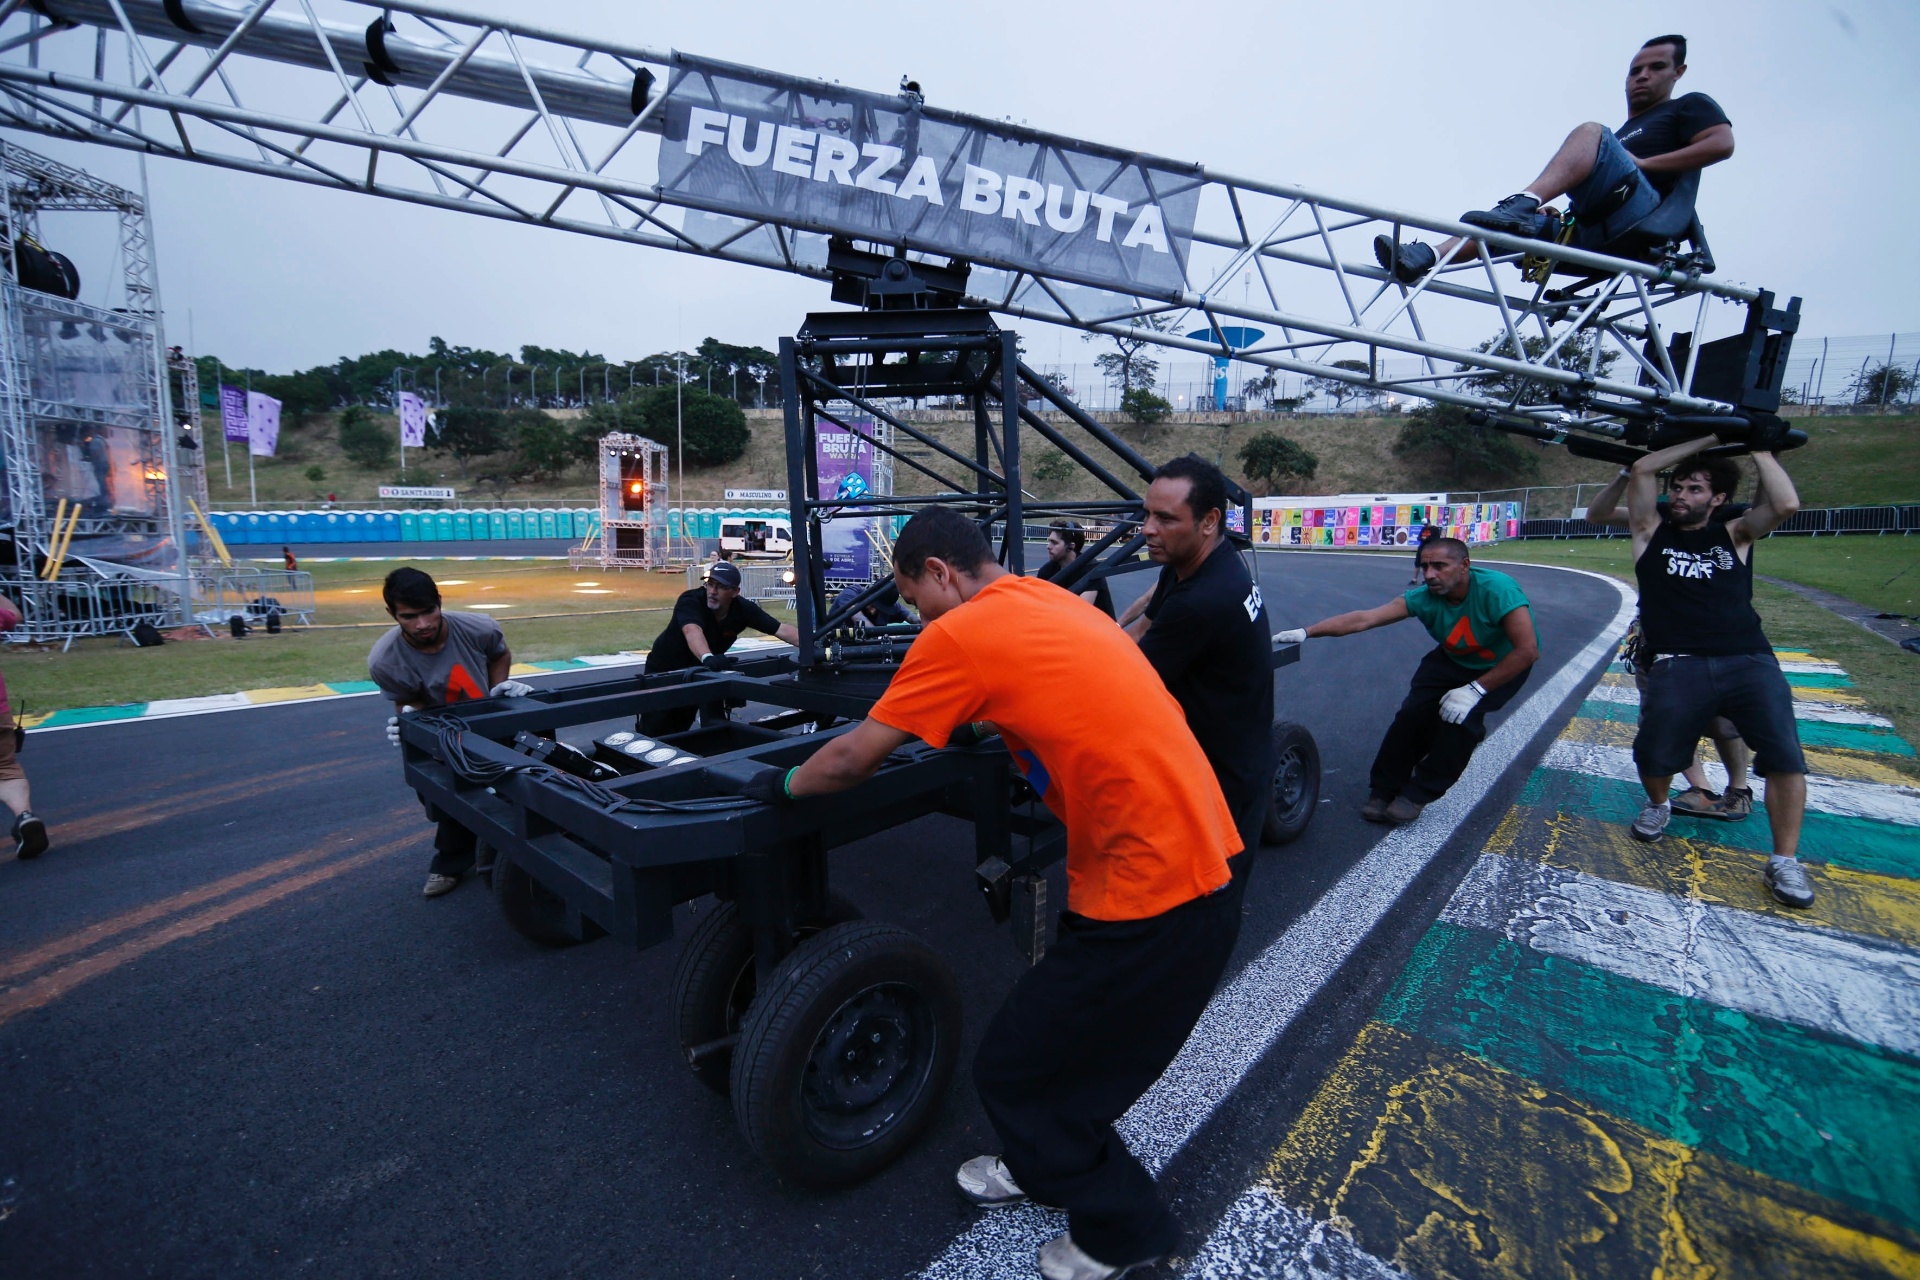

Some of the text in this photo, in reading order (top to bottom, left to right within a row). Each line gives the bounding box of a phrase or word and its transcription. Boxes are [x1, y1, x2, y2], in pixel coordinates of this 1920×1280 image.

[686, 107, 1170, 254] FUERZA BRUTA
[823, 443, 867, 453] BRUTA
[1666, 557, 1713, 579] STAFF
[1243, 580, 1263, 623] EQ
